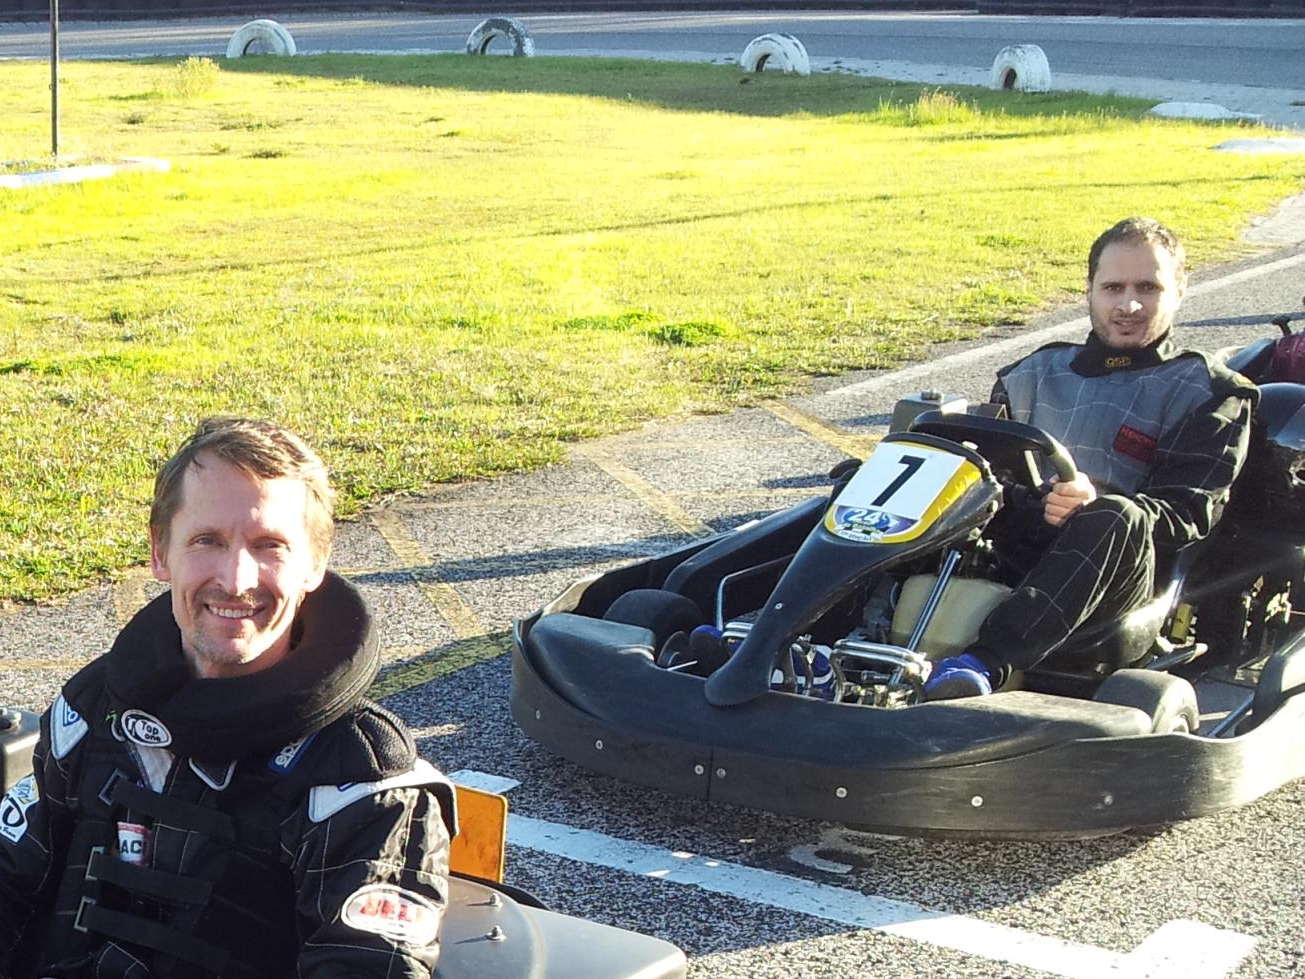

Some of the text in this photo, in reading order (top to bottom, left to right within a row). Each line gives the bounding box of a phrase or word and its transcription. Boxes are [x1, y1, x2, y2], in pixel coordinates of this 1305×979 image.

[870, 454, 927, 507] 7
[847, 509, 884, 527] 24
[140, 720, 160, 736] Top
